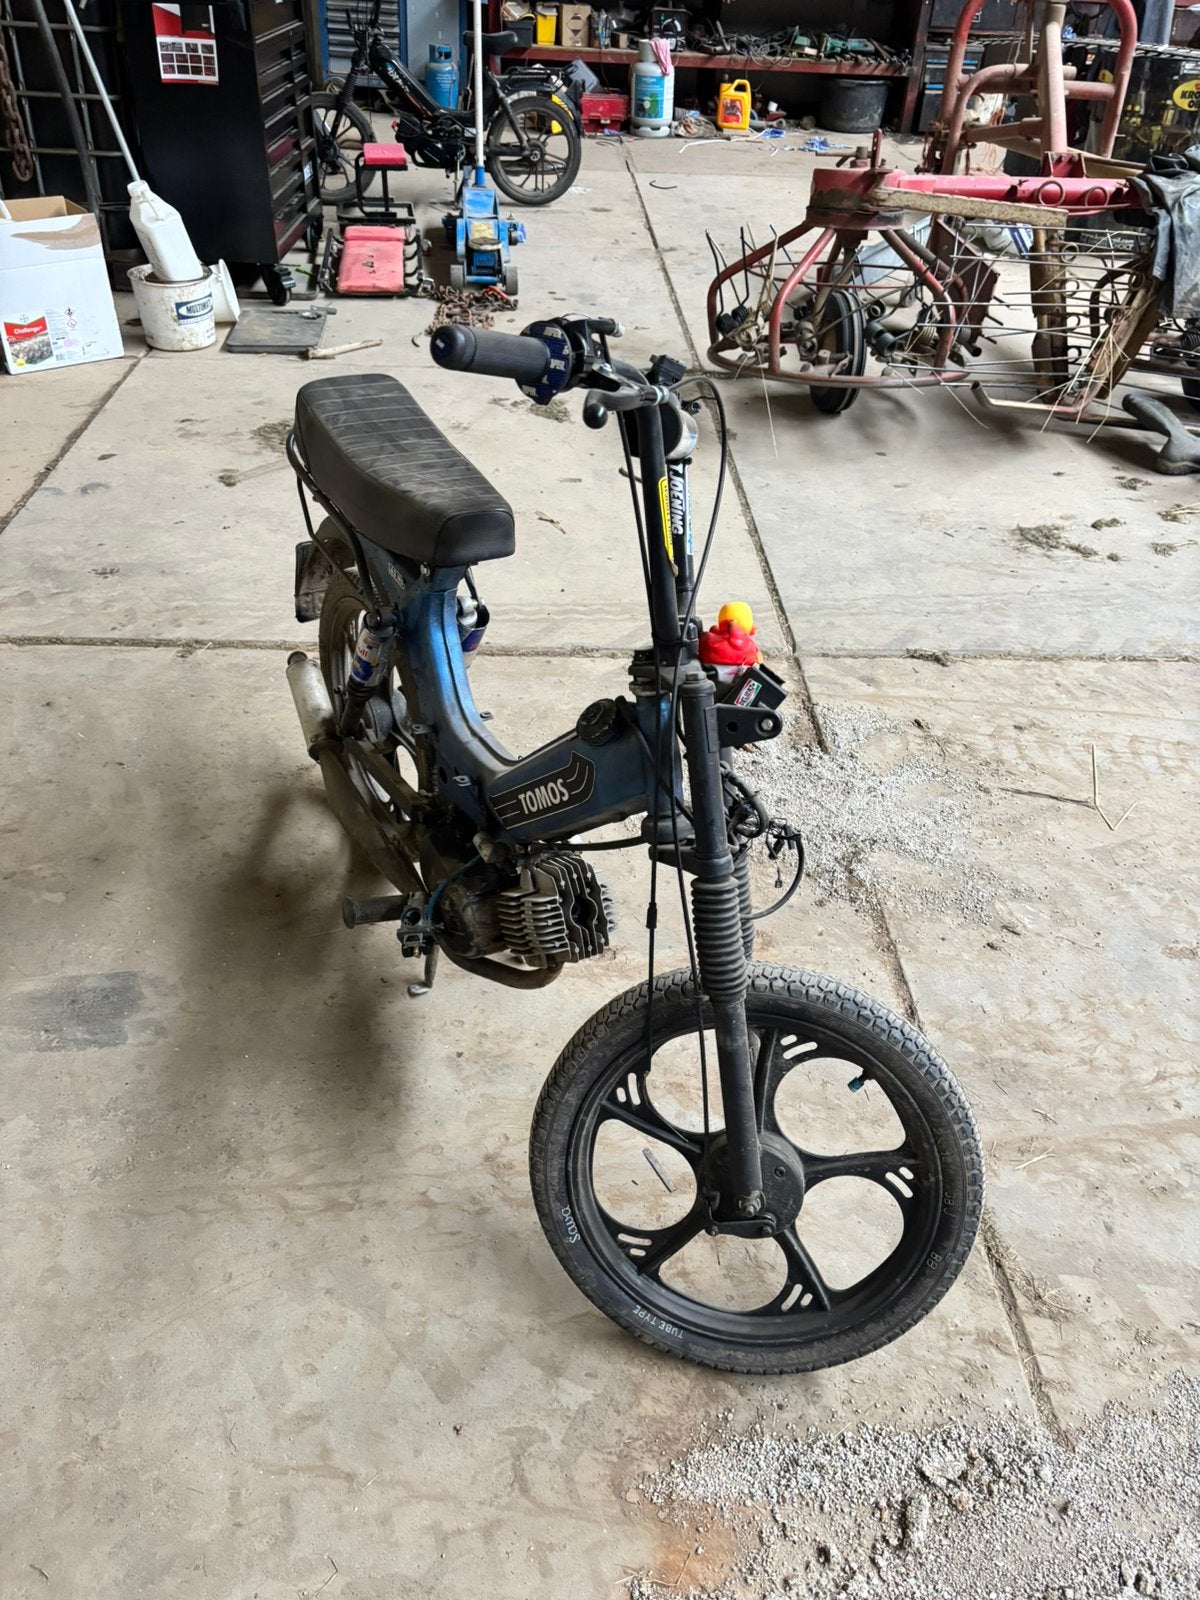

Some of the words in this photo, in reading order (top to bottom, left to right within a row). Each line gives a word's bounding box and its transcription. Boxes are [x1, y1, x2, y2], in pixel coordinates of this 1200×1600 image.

[518, 778, 569, 815] TOMOS
[632, 1304, 657, 1326] TYPE
[658, 1320, 684, 1339] TUBE
